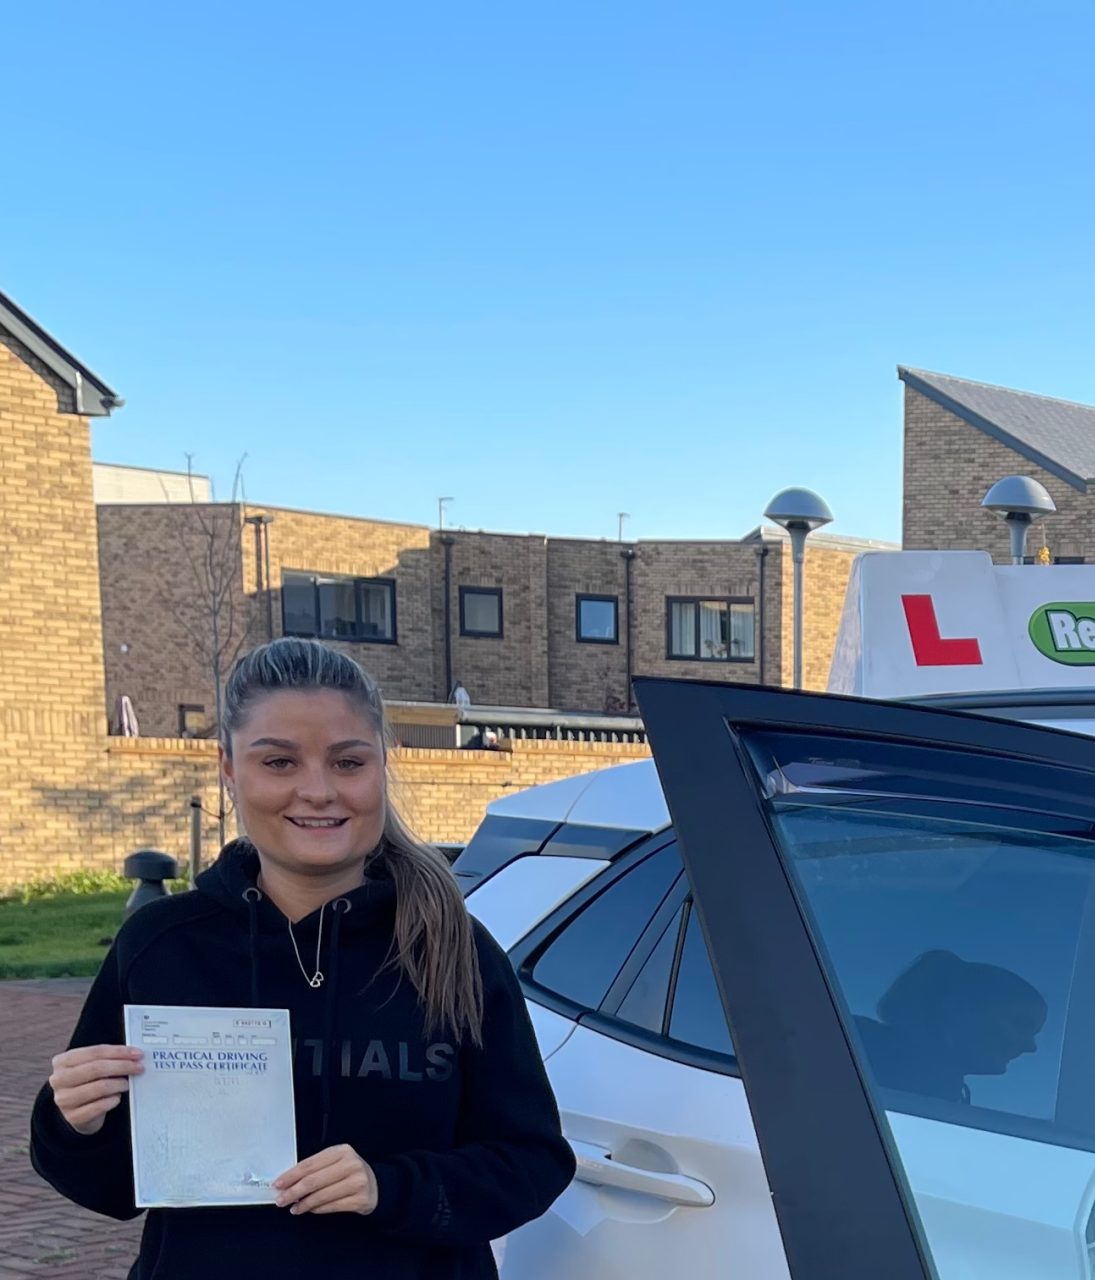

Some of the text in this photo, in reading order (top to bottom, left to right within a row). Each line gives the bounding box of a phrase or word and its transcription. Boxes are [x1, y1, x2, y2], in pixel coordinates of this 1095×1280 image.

[901, 594, 982, 665] L
[153, 1051, 268, 1061] PRACTICAL DRIVING
[154, 1061, 267, 1072] TEST PASS CERTIFICATE
[293, 1038, 455, 1081] TIALS
